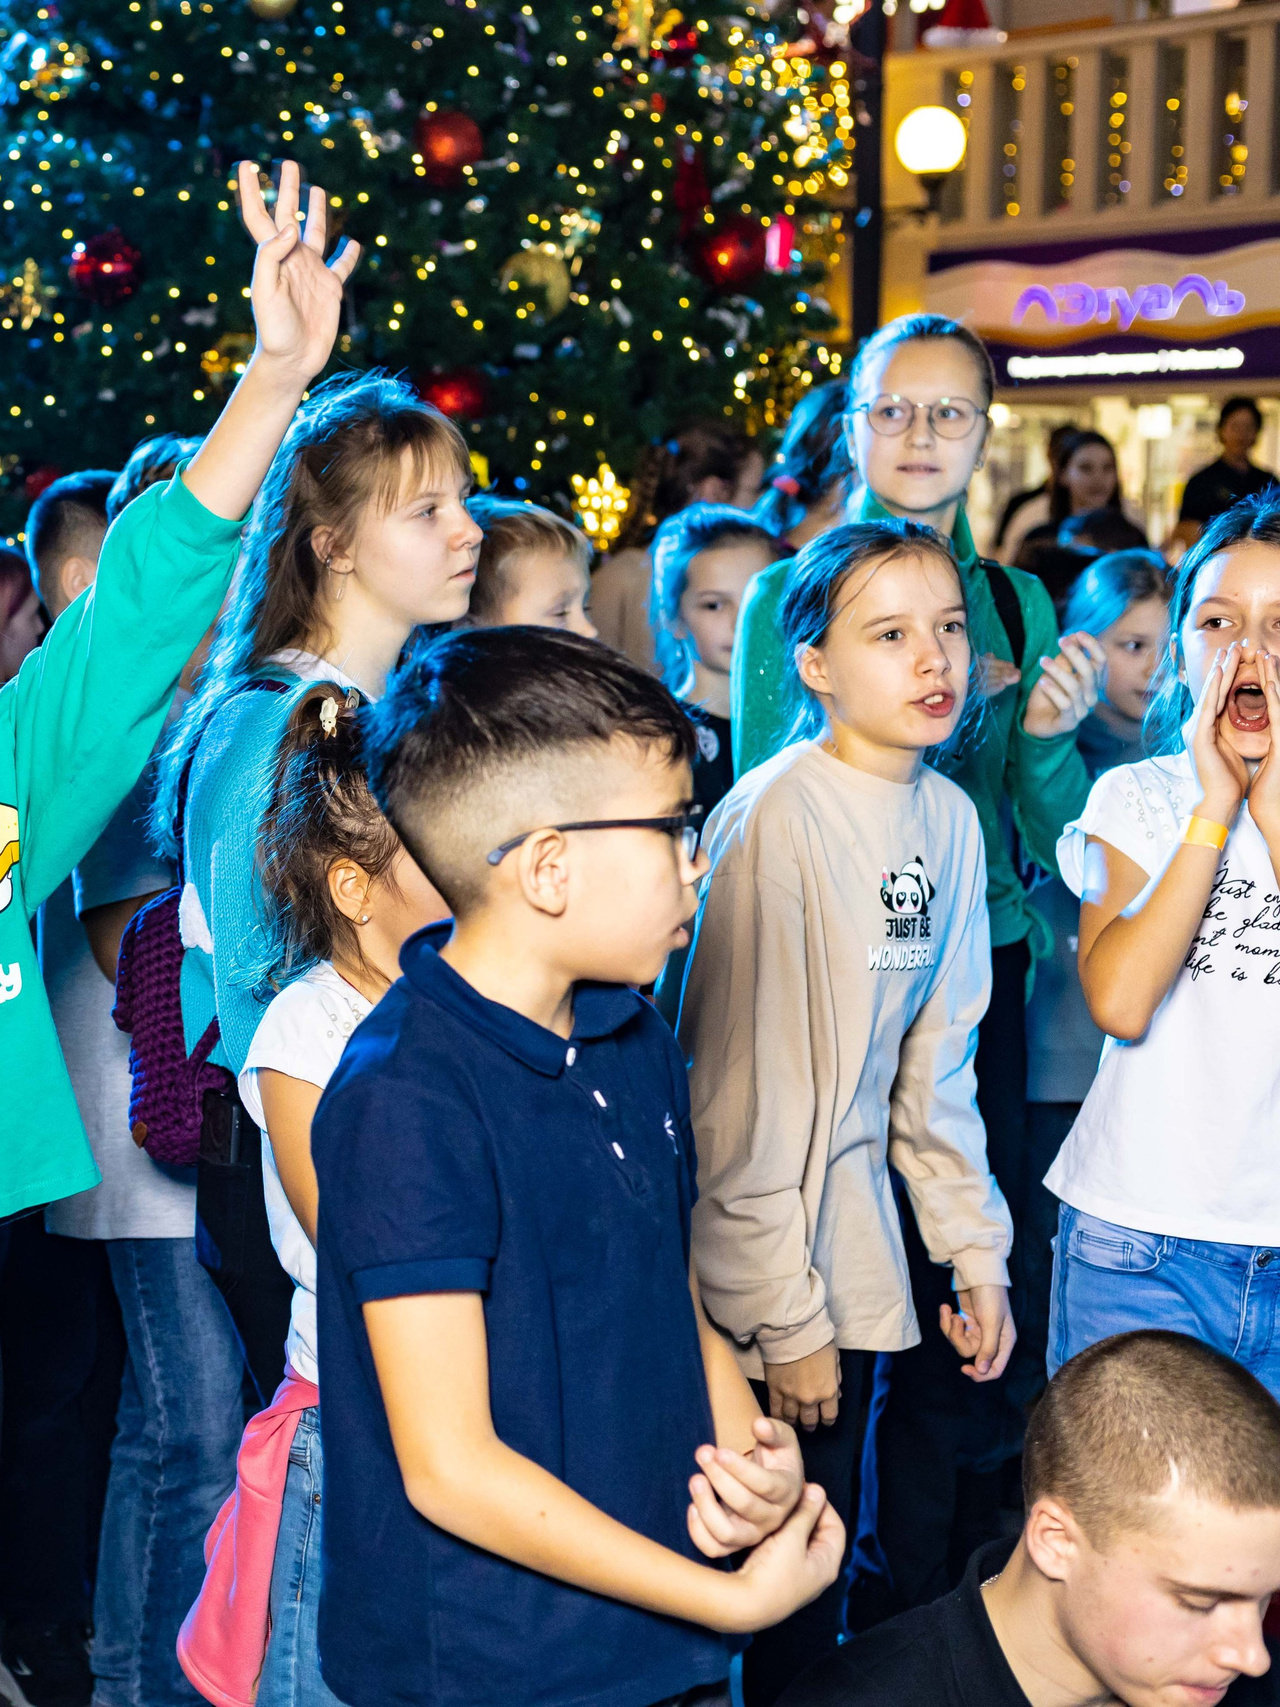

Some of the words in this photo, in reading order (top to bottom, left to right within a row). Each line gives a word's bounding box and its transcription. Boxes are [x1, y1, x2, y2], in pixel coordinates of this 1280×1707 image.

[886, 917, 918, 941] JUST
[919, 916, 932, 941] BE
[1231, 967, 1248, 981] is
